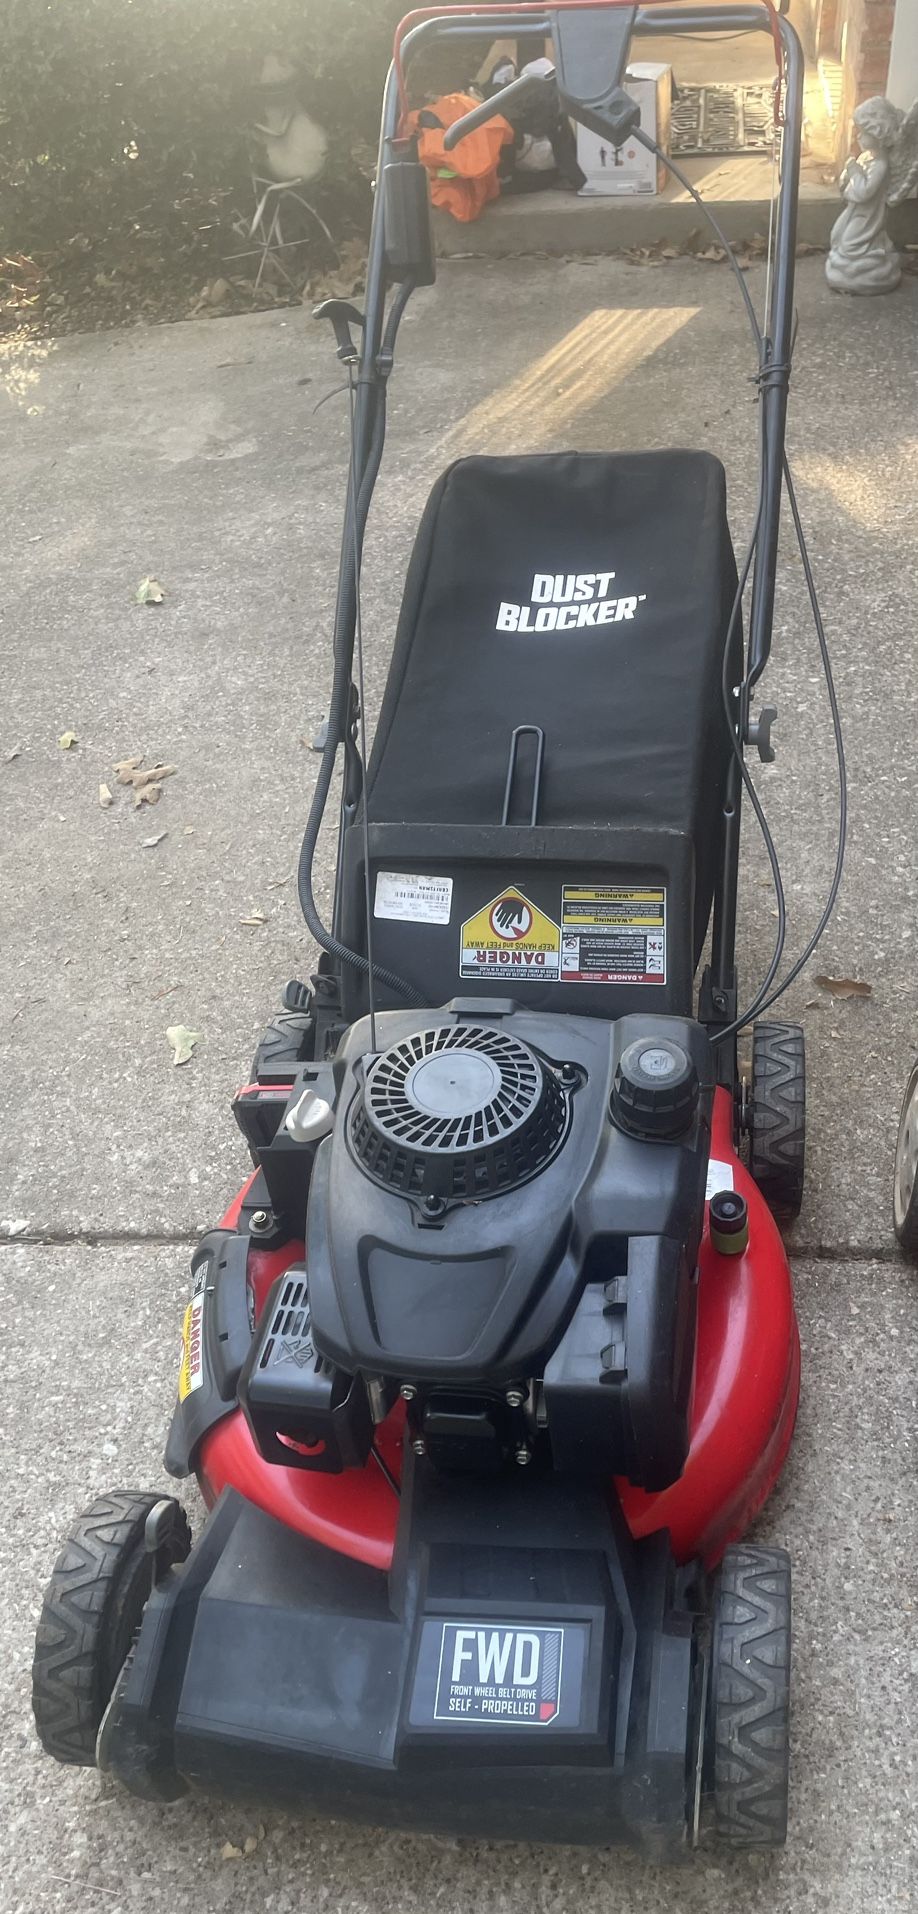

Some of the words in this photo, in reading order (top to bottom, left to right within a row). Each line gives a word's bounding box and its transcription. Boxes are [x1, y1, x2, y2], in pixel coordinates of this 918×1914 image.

[531, 572, 615, 603] DUST
[476, 951, 545, 965] DANGER
[190, 1306, 202, 1377] DANGER
[452, 1630, 540, 1685] FWD
[450, 1686, 472, 1696] FRONT
[474, 1687, 496, 1698] WHEEL
[498, 1688, 514, 1698] BELT
[516, 1689, 537, 1700] DRIVE
[449, 1698, 472, 1711] SELF
[482, 1702, 536, 1715] PROPELLED
